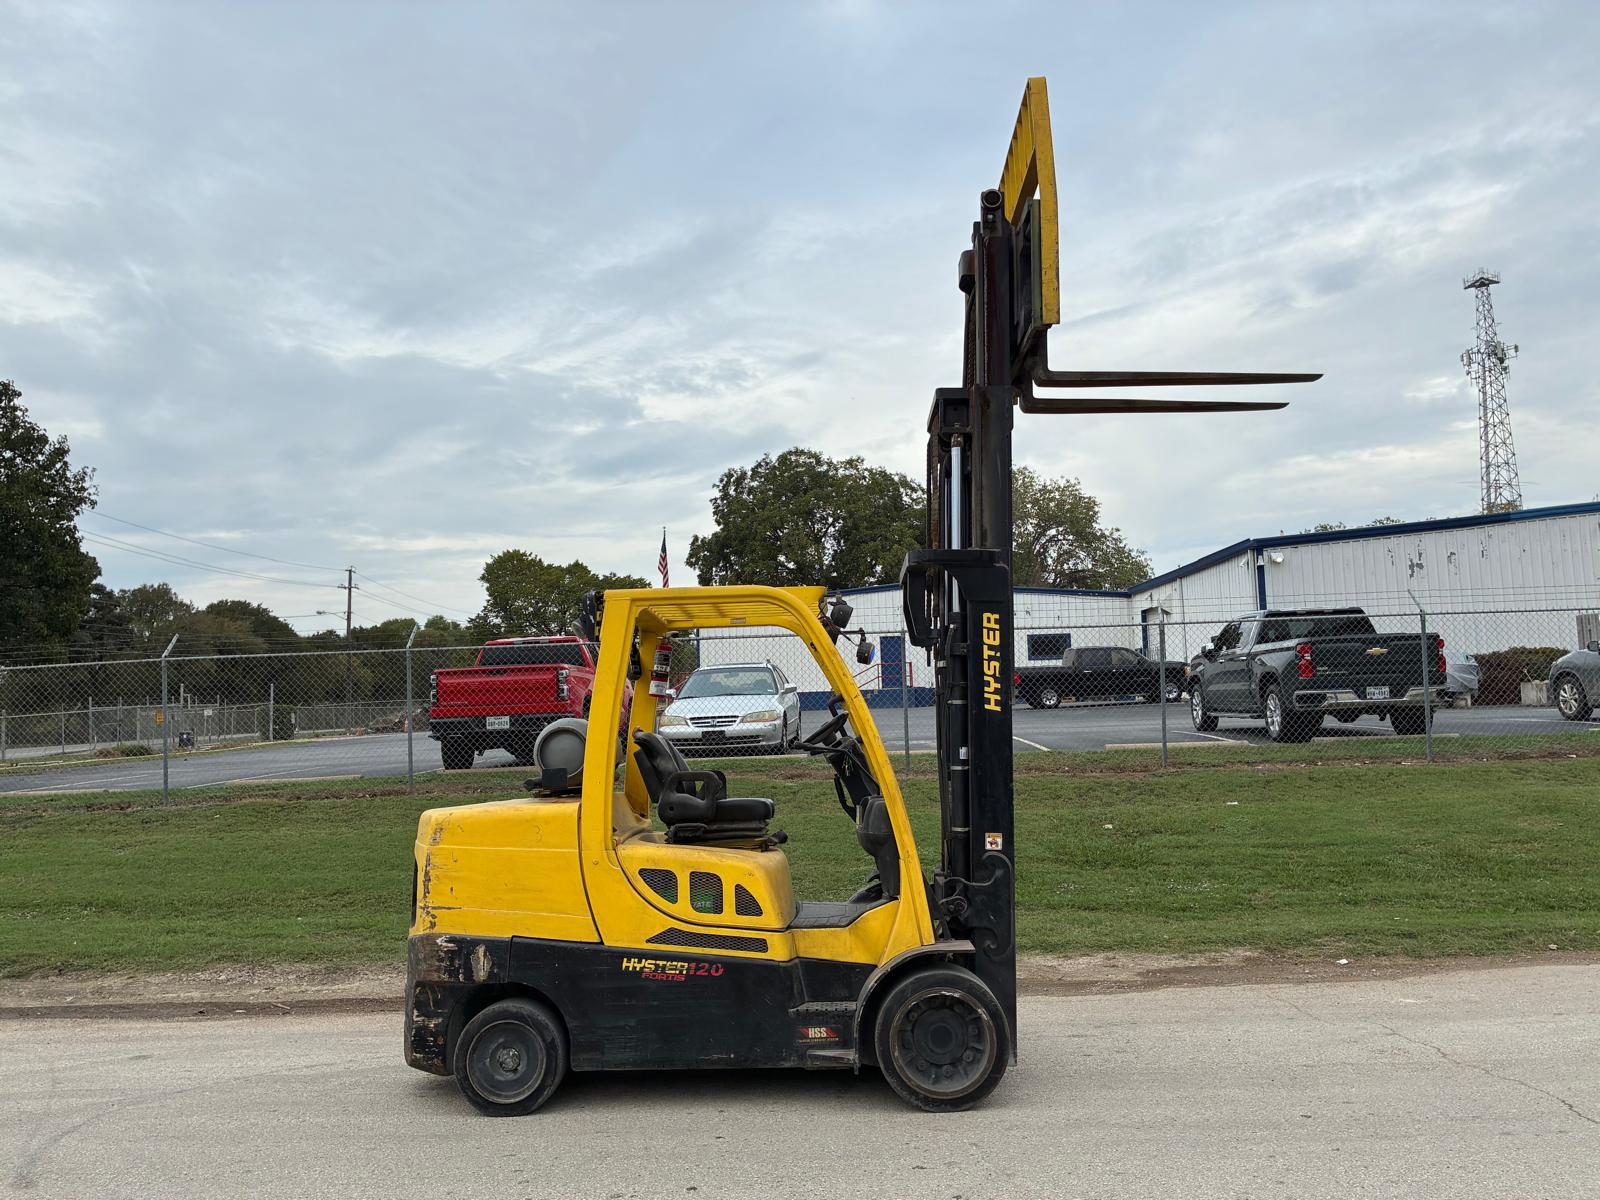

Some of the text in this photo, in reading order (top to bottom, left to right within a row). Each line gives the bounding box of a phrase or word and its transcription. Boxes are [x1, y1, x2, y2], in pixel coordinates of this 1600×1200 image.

[983, 612, 1001, 712] HYSTER
[622, 957, 724, 977] HYSTER 120
[641, 972, 686, 982] FORTIS
[808, 1027, 827, 1038] HSS
